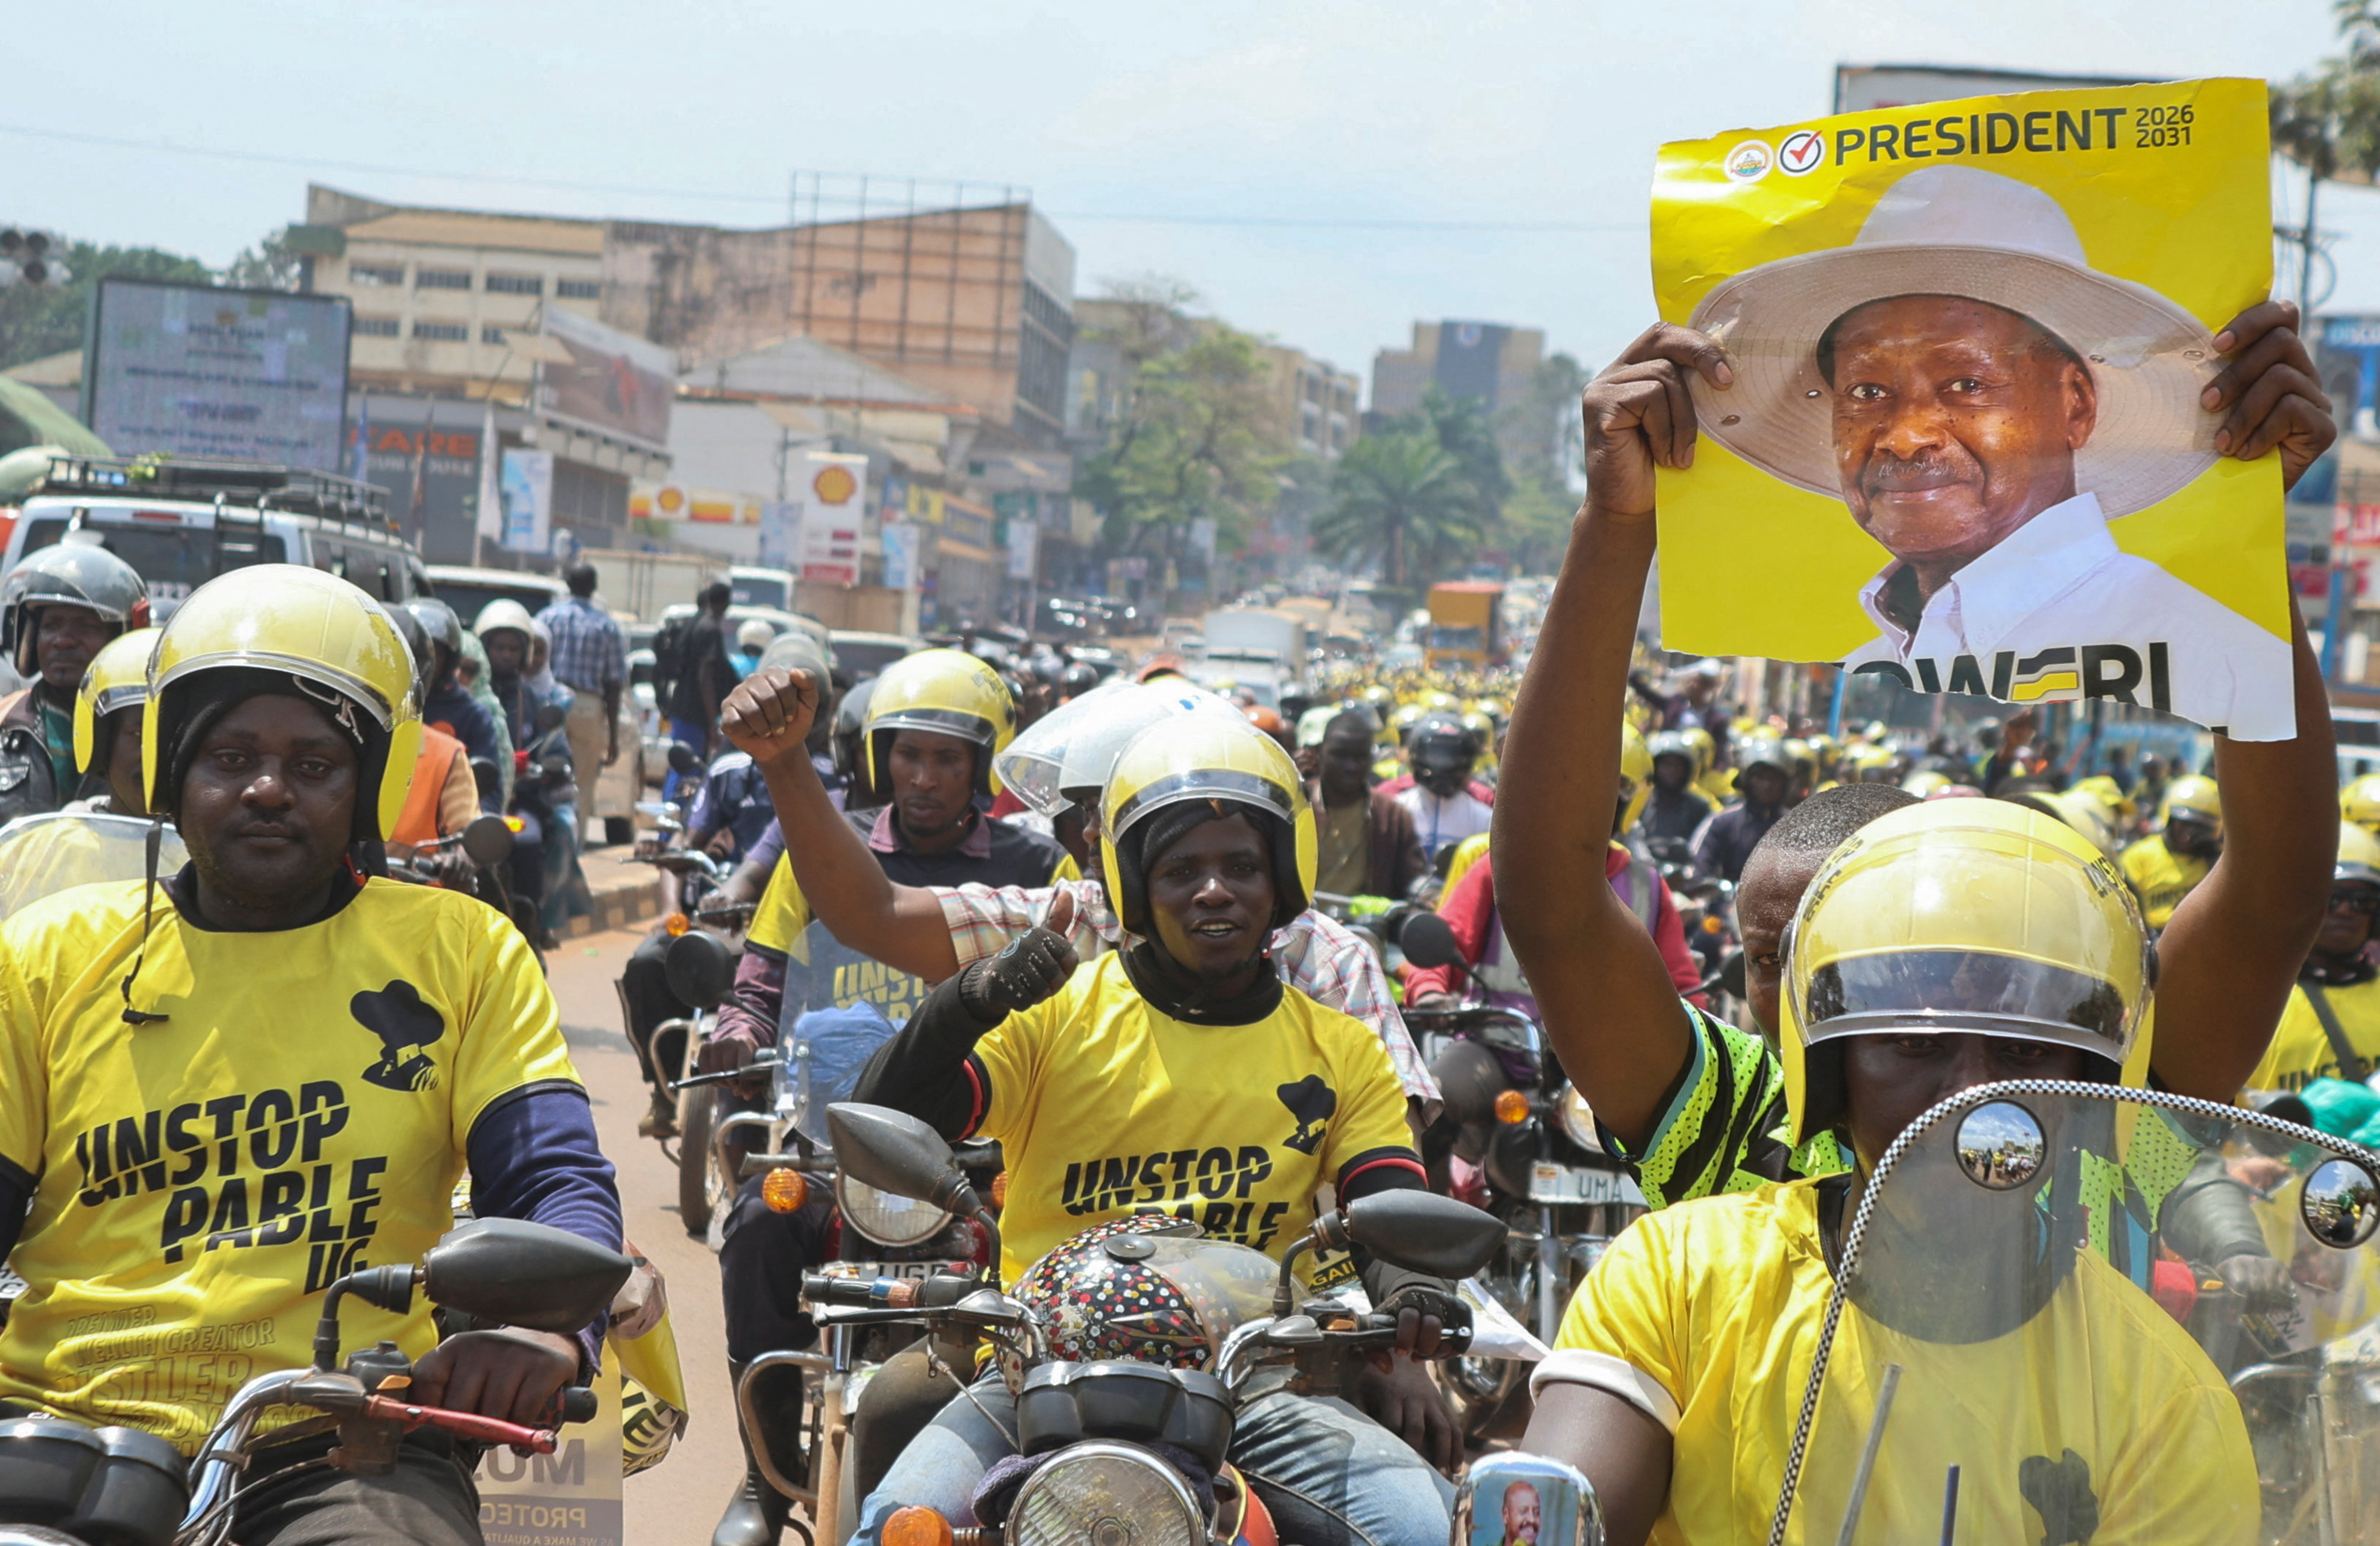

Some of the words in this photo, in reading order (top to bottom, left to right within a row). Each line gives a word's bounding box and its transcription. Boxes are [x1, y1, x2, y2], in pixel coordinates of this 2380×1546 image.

[1835, 107, 2126, 166] PRESIDENT
[2136, 104, 2194, 126] 2026
[2136, 126, 2192, 148] 2031
[75, 1080, 350, 1207] UNSTOP
[160, 1156, 386, 1265] PABLE
[1062, 1146, 1274, 1216] UNSTOP
[163, 1317, 275, 1353] CREATOR
